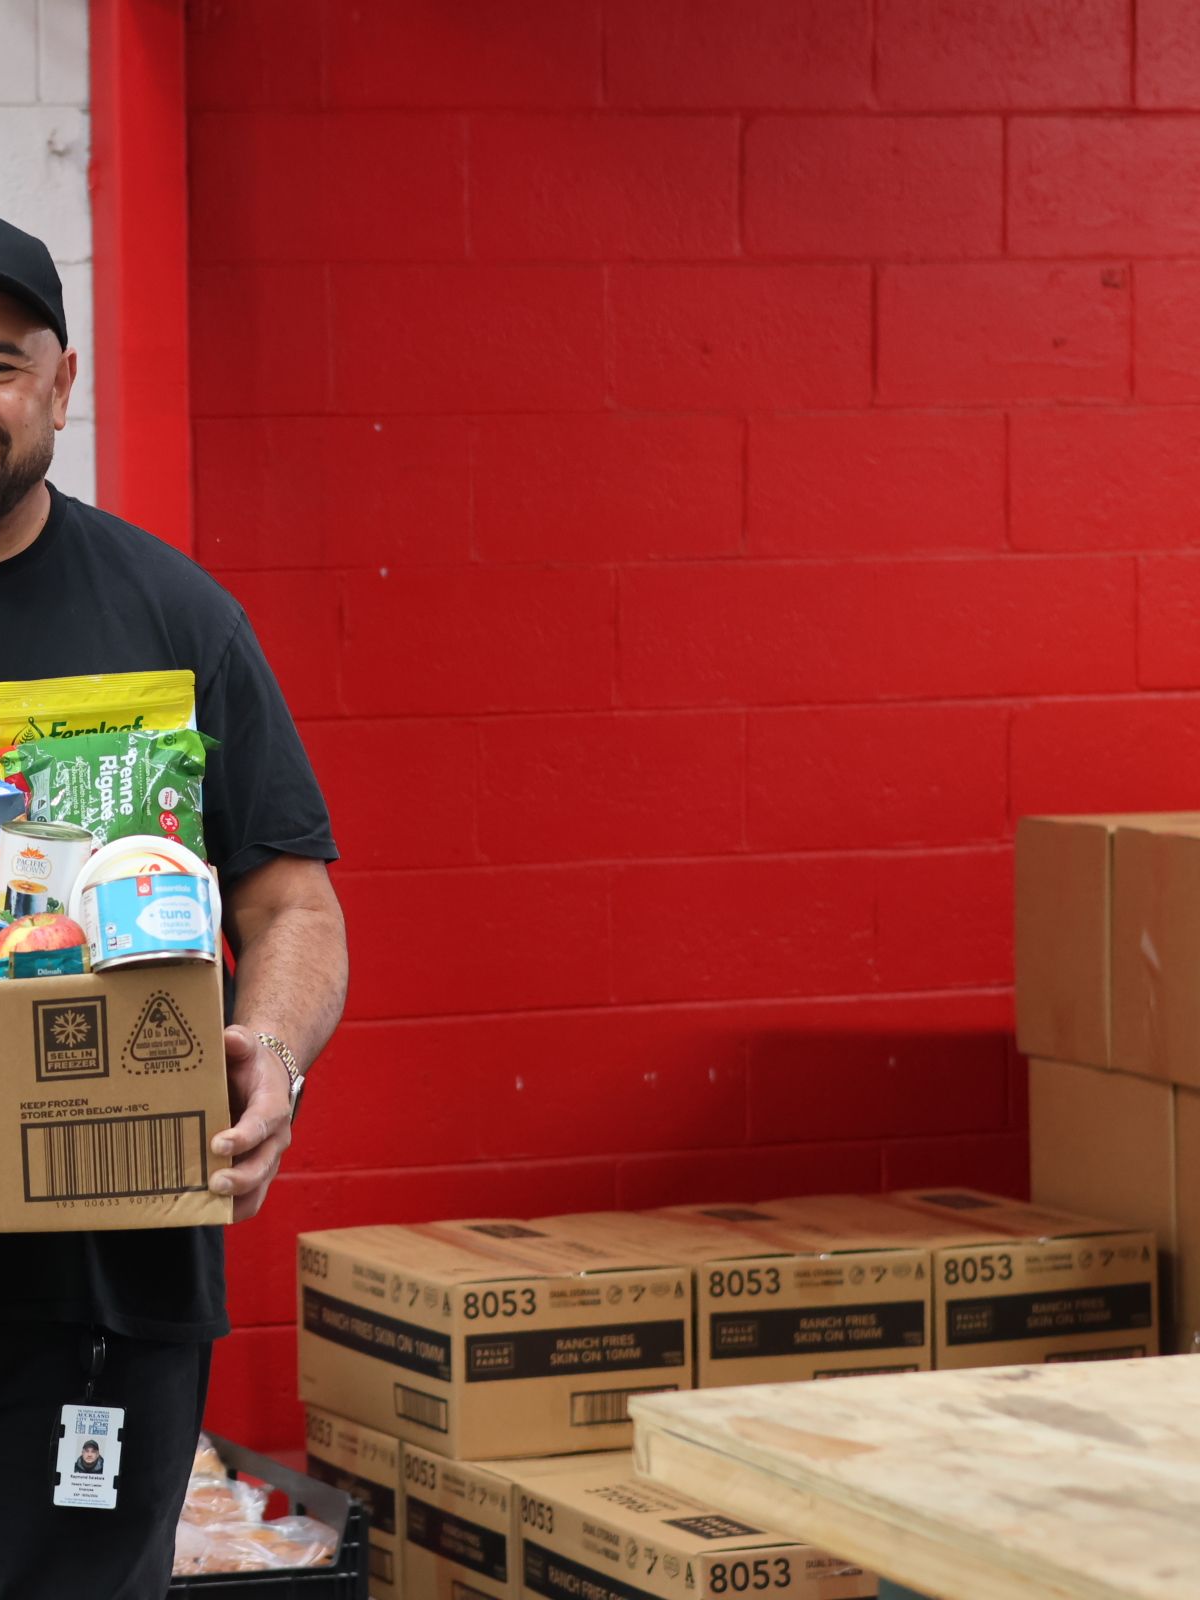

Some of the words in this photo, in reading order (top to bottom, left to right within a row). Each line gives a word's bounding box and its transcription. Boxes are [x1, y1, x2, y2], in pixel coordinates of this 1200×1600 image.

[95, 755, 118, 822] Rigate
[119, 753, 138, 816] Penne
[16, 858, 47, 867] PACIFIC
[16, 864, 45, 874] CROWN
[160, 908, 192, 919] tuna
[37, 967, 62, 976] Dilmah
[143, 1028, 154, 1039] 10
[50, 1052, 77, 1060] SELL
[47, 1060, 97, 1070] FREEZER
[144, 1061, 180, 1070] CAUTION
[20, 1101, 46, 1110] KEEP
[48, 1098, 89, 1108] FROZEN
[21, 1110, 54, 1120] STORE
[55, 1110, 67, 1118] AT
[69, 1108, 84, 1117] OR
[86, 1106, 123, 1115] BELOW
[125, 1103, 149, 1113] -18°C
[56, 1201, 75, 1209] 193
[301, 1245, 328, 1279] 8053
[944, 1254, 1013, 1285] 8053
[709, 1267, 782, 1298] 8053
[464, 1288, 536, 1320] 8053
[1032, 1301, 1073, 1314] RANCH
[800, 1316, 842, 1329] RANCH
[845, 1314, 877, 1326] FRIES
[1026, 1317, 1053, 1329] SKIN
[1056, 1315, 1075, 1326] ON
[321, 1307, 350, 1331] RANCH
[351, 1317, 374, 1341] FRIES
[375, 1326, 396, 1347] SKIN
[397, 1334, 413, 1353] ON
[415, 1340, 445, 1363] 10MM
[556, 1336, 600, 1349] RANCH
[602, 1334, 635, 1347] FRIES
[793, 1332, 821, 1344] SKIN
[824, 1330, 844, 1342] ON
[848, 1328, 884, 1340] 10MM
[550, 1353, 579, 1366] SKIN
[581, 1351, 601, 1363] ON
[606, 1348, 641, 1361] 10MM
[405, 1454, 436, 1490] 8053
[521, 1495, 554, 1535] 8053
[547, 1565, 580, 1593] RANCH
[710, 1558, 792, 1594] 8053
